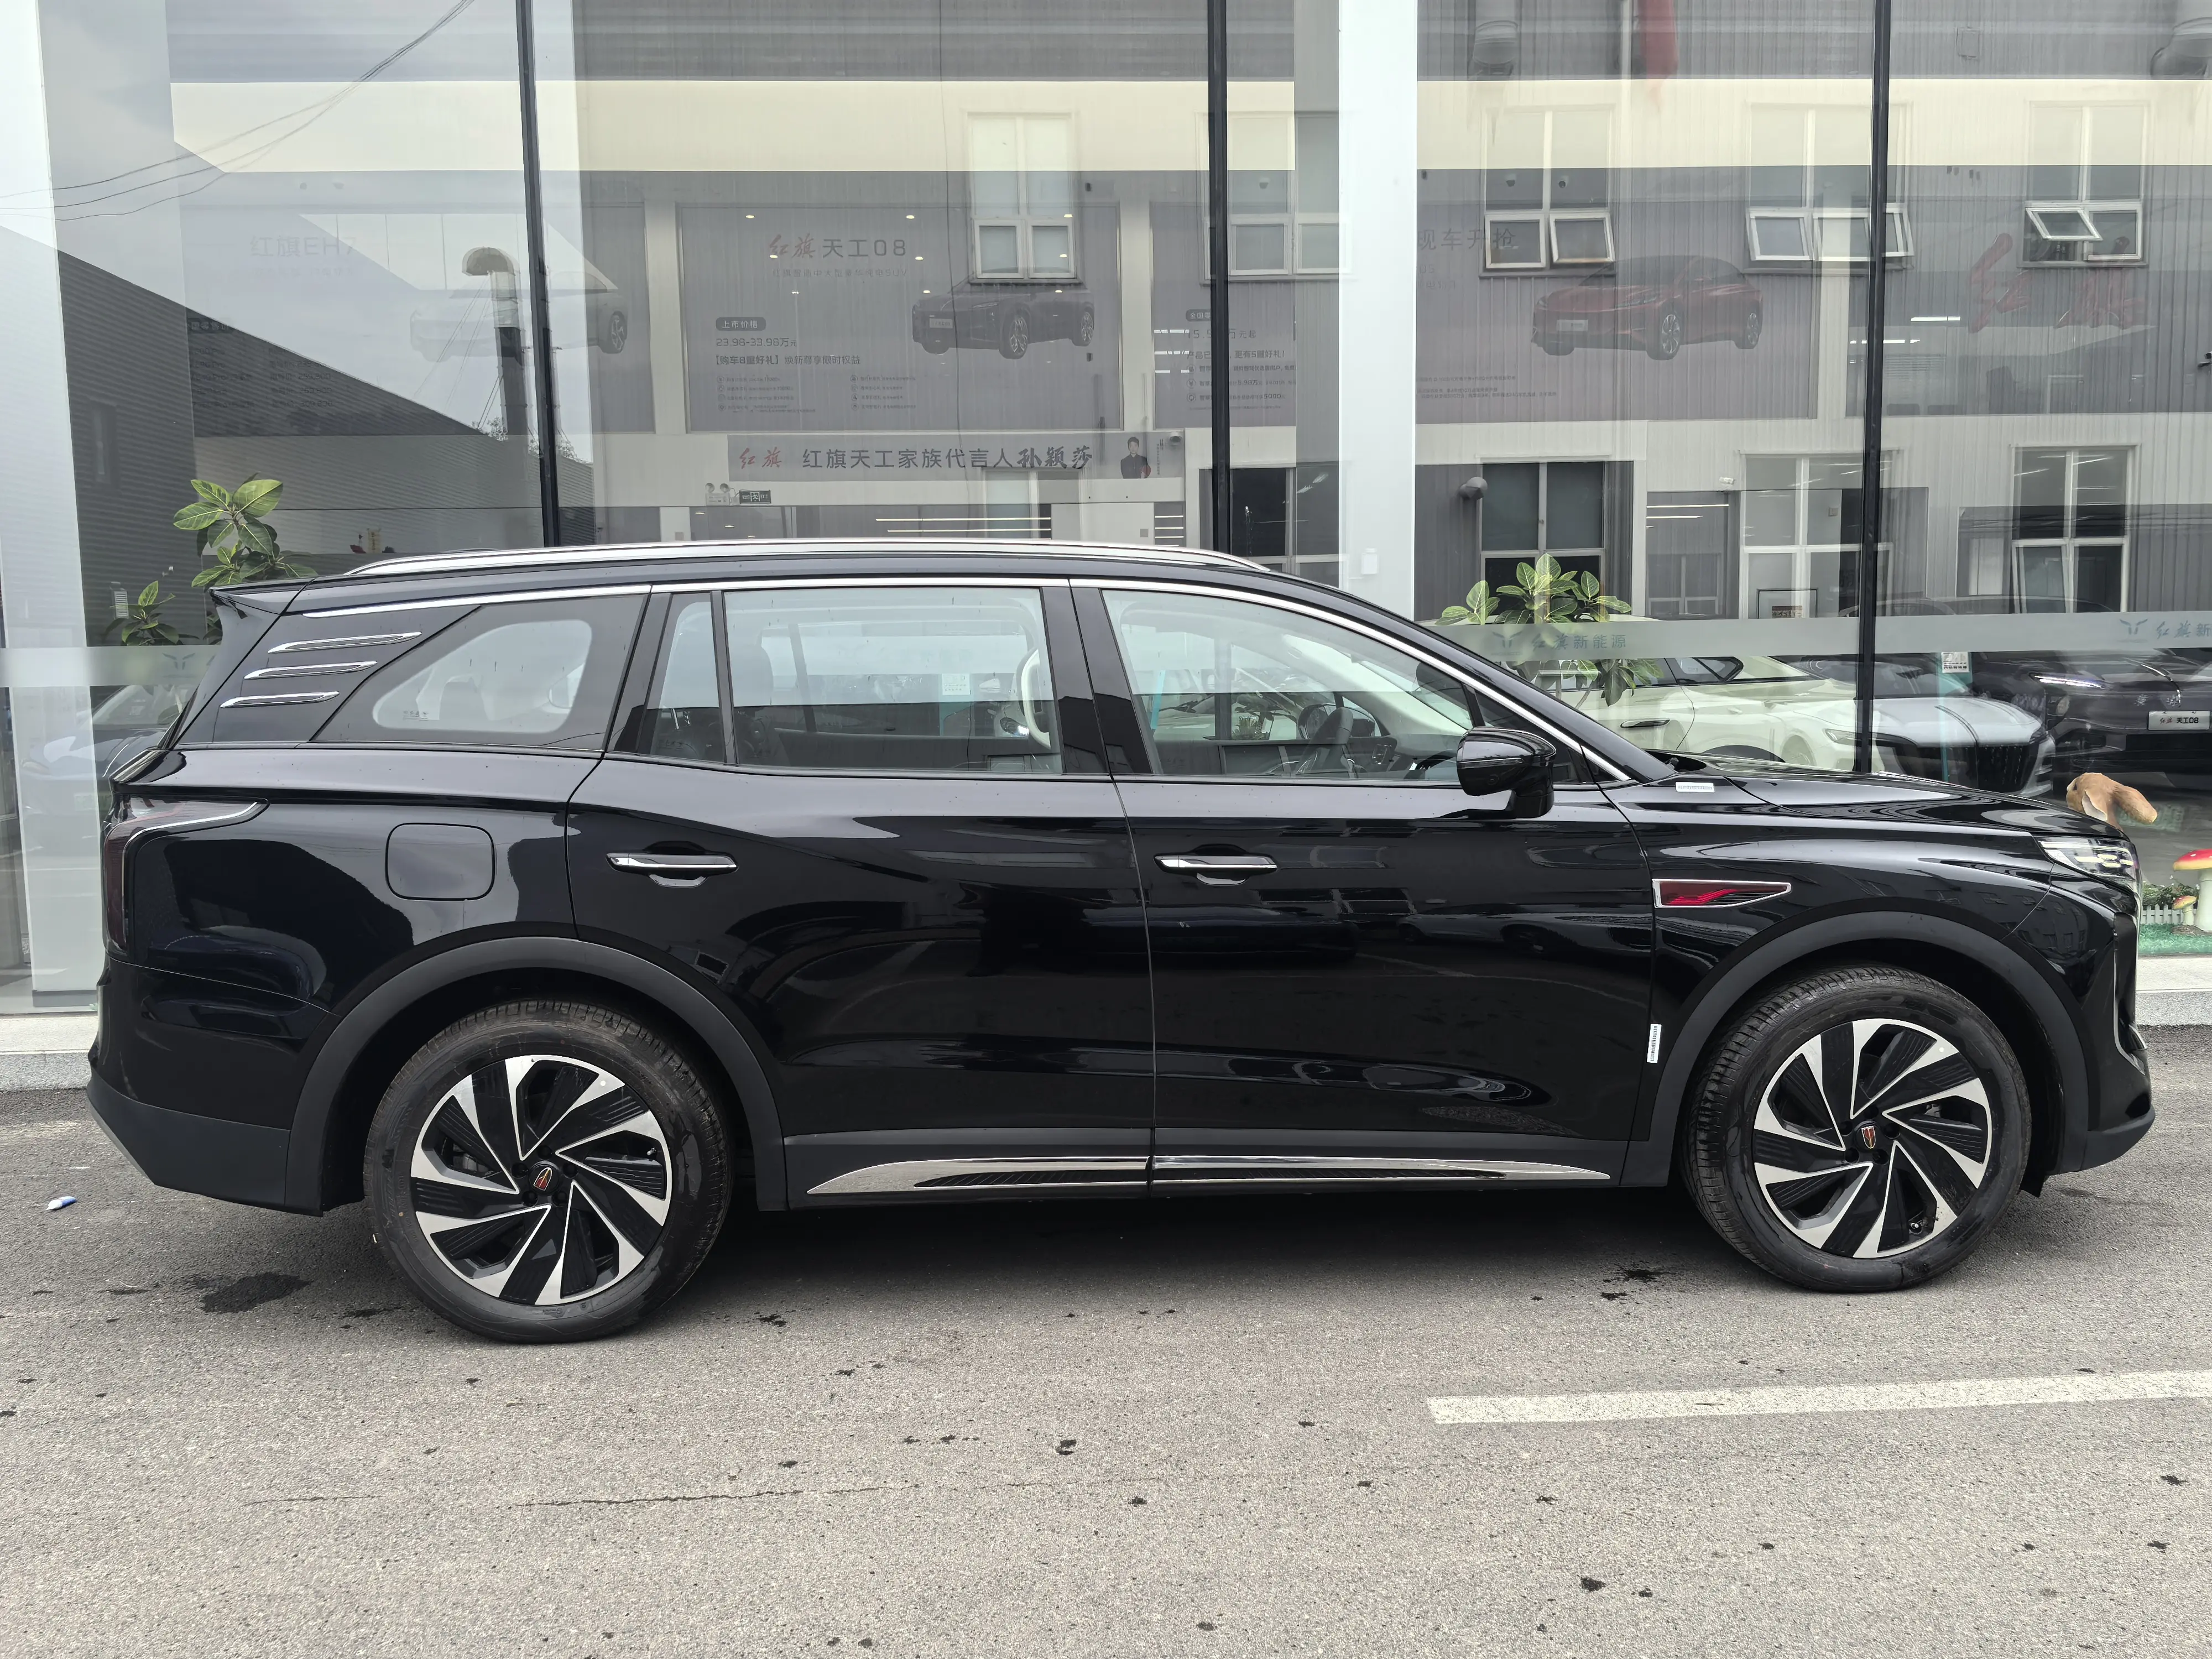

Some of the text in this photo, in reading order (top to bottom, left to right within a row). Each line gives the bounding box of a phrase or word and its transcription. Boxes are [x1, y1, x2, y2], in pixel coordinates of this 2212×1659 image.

[822, 239, 906, 259] 天工08
[722, 320, 758, 329] 上市价格
